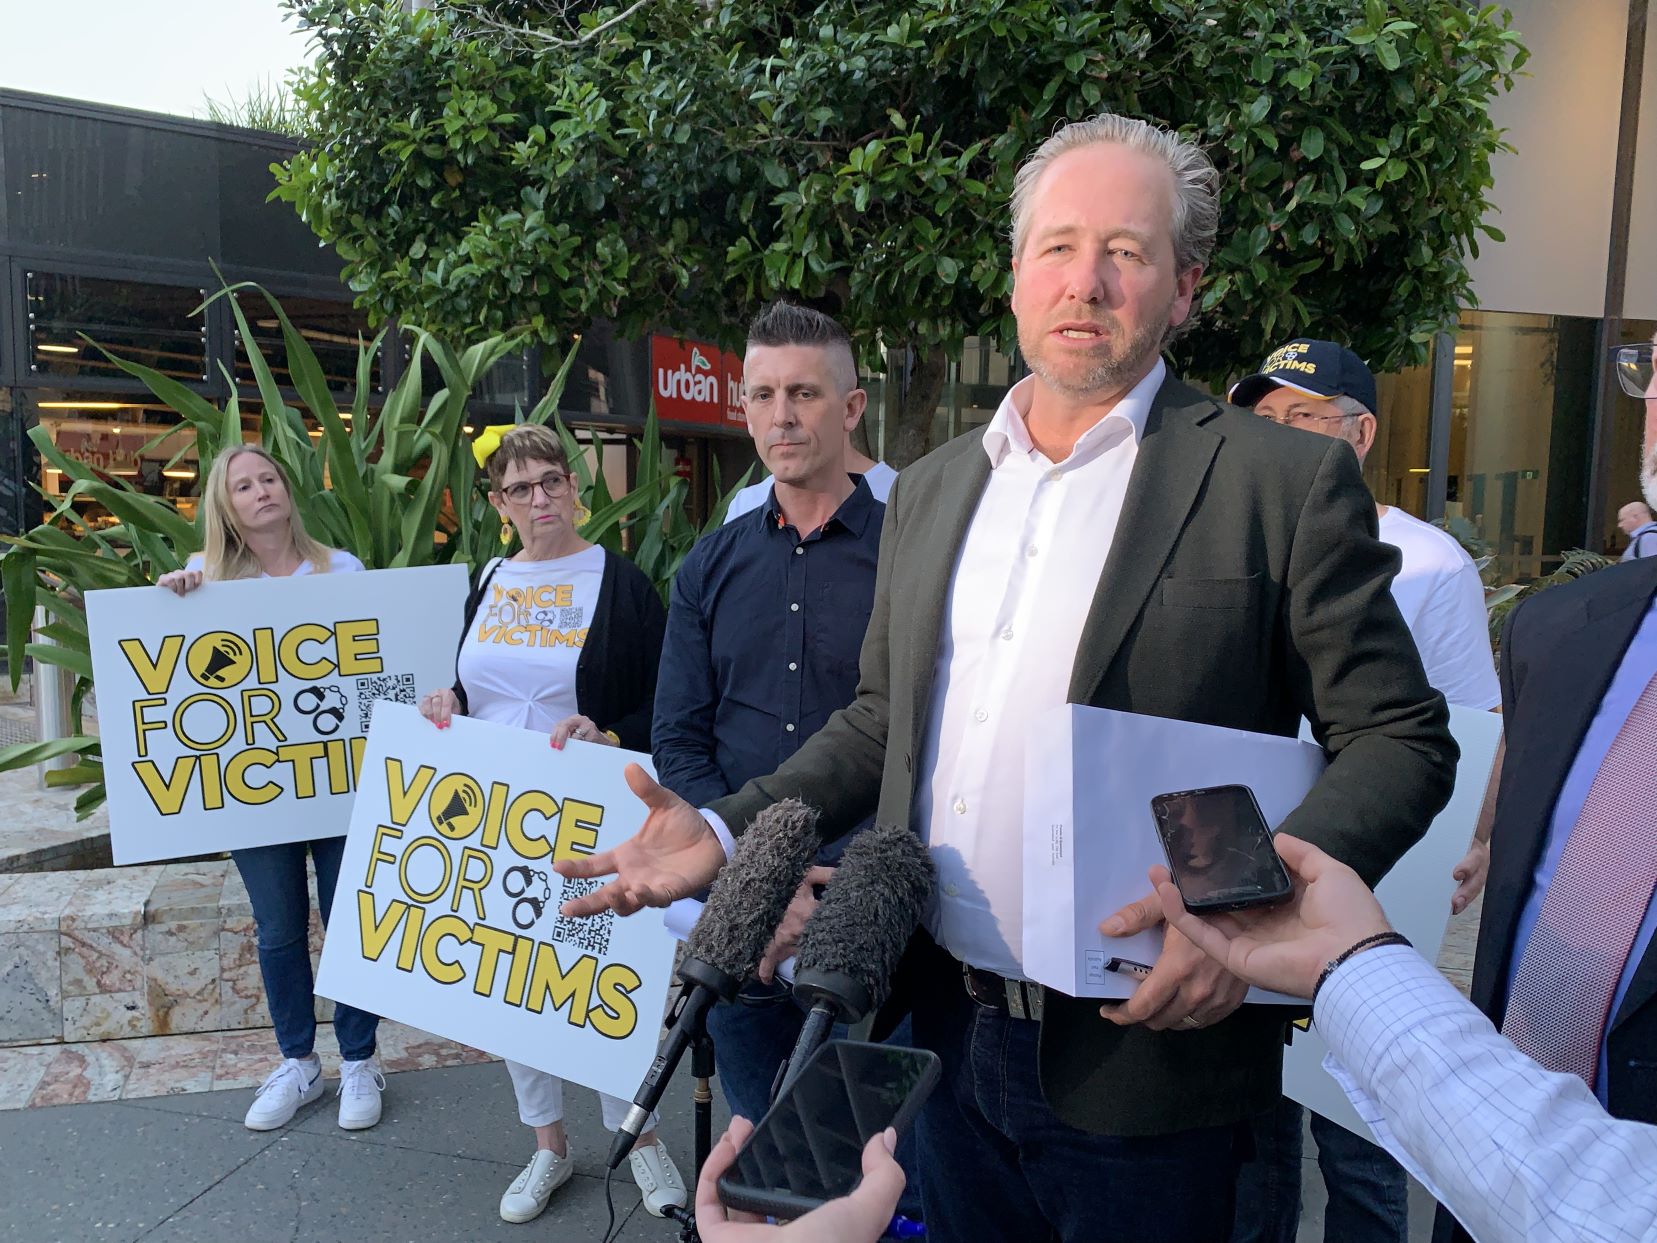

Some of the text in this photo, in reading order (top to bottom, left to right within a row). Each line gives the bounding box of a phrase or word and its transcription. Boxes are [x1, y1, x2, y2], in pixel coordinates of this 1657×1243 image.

[658, 364, 718, 404] urban
[483, 601, 531, 626] FOR
[492, 583, 573, 609] VOICE
[118, 618, 383, 695] VOICE
[478, 623, 590, 648] VICTIMS
[132, 688, 287, 757] FOR
[131, 736, 367, 816] VICTI
[385, 757, 604, 864] VOICE
[365, 825, 493, 920] FOR
[357, 889, 642, 1040] VICTIMS
